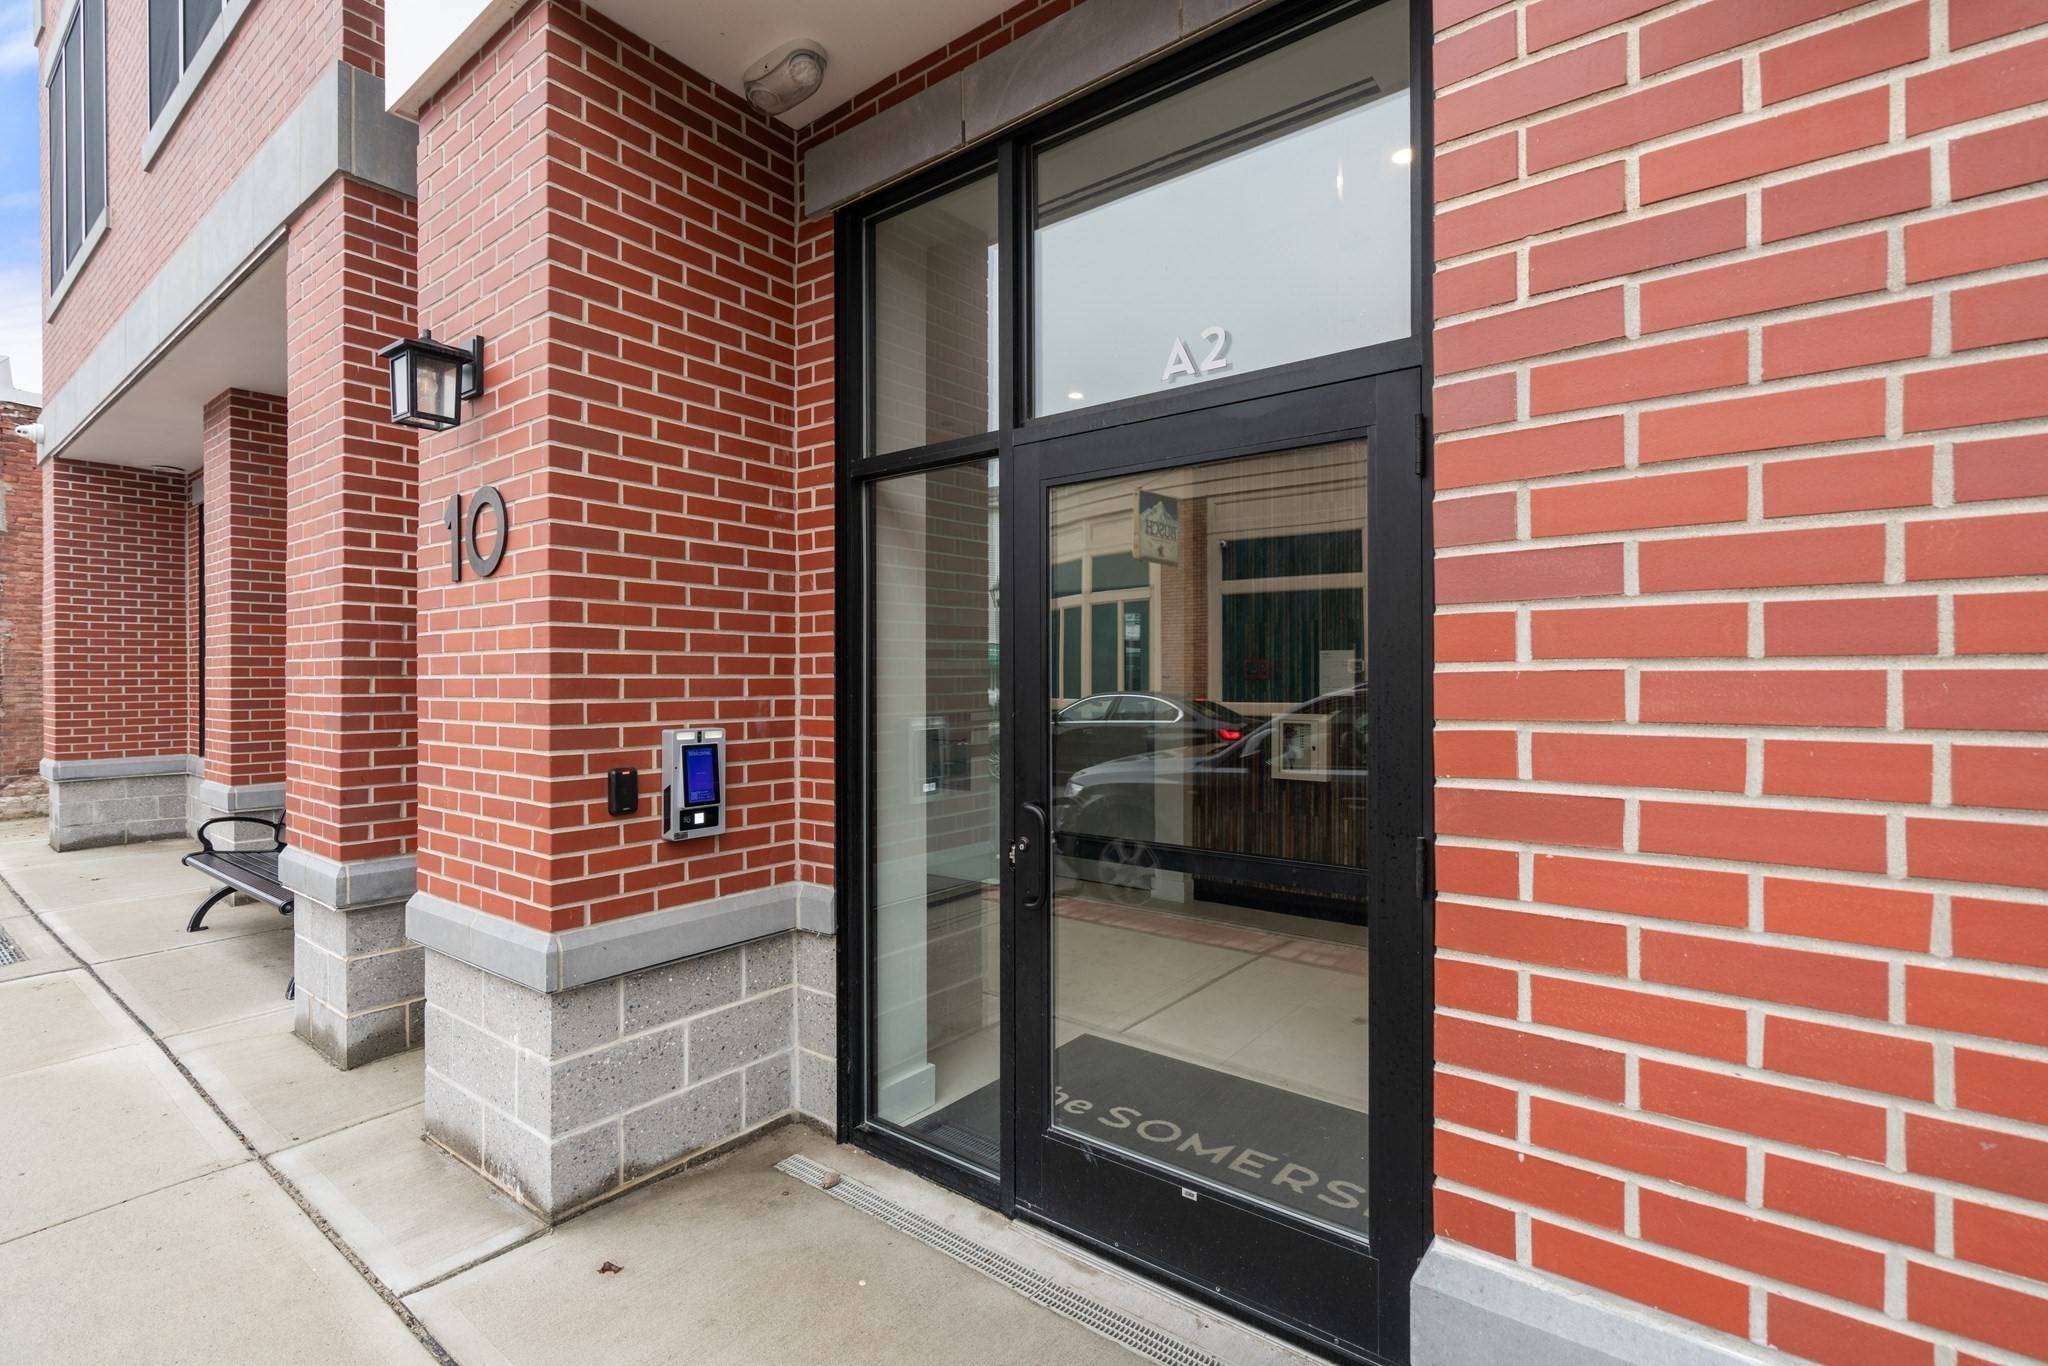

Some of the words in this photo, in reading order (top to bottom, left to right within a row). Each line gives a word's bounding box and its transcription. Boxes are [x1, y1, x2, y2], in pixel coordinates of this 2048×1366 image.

[1161, 325, 1229, 382] A2
[444, 486, 508, 582] 10
[1055, 1086, 1093, 1114] he
[1097, 1107, 1369, 1216] SOMERS
